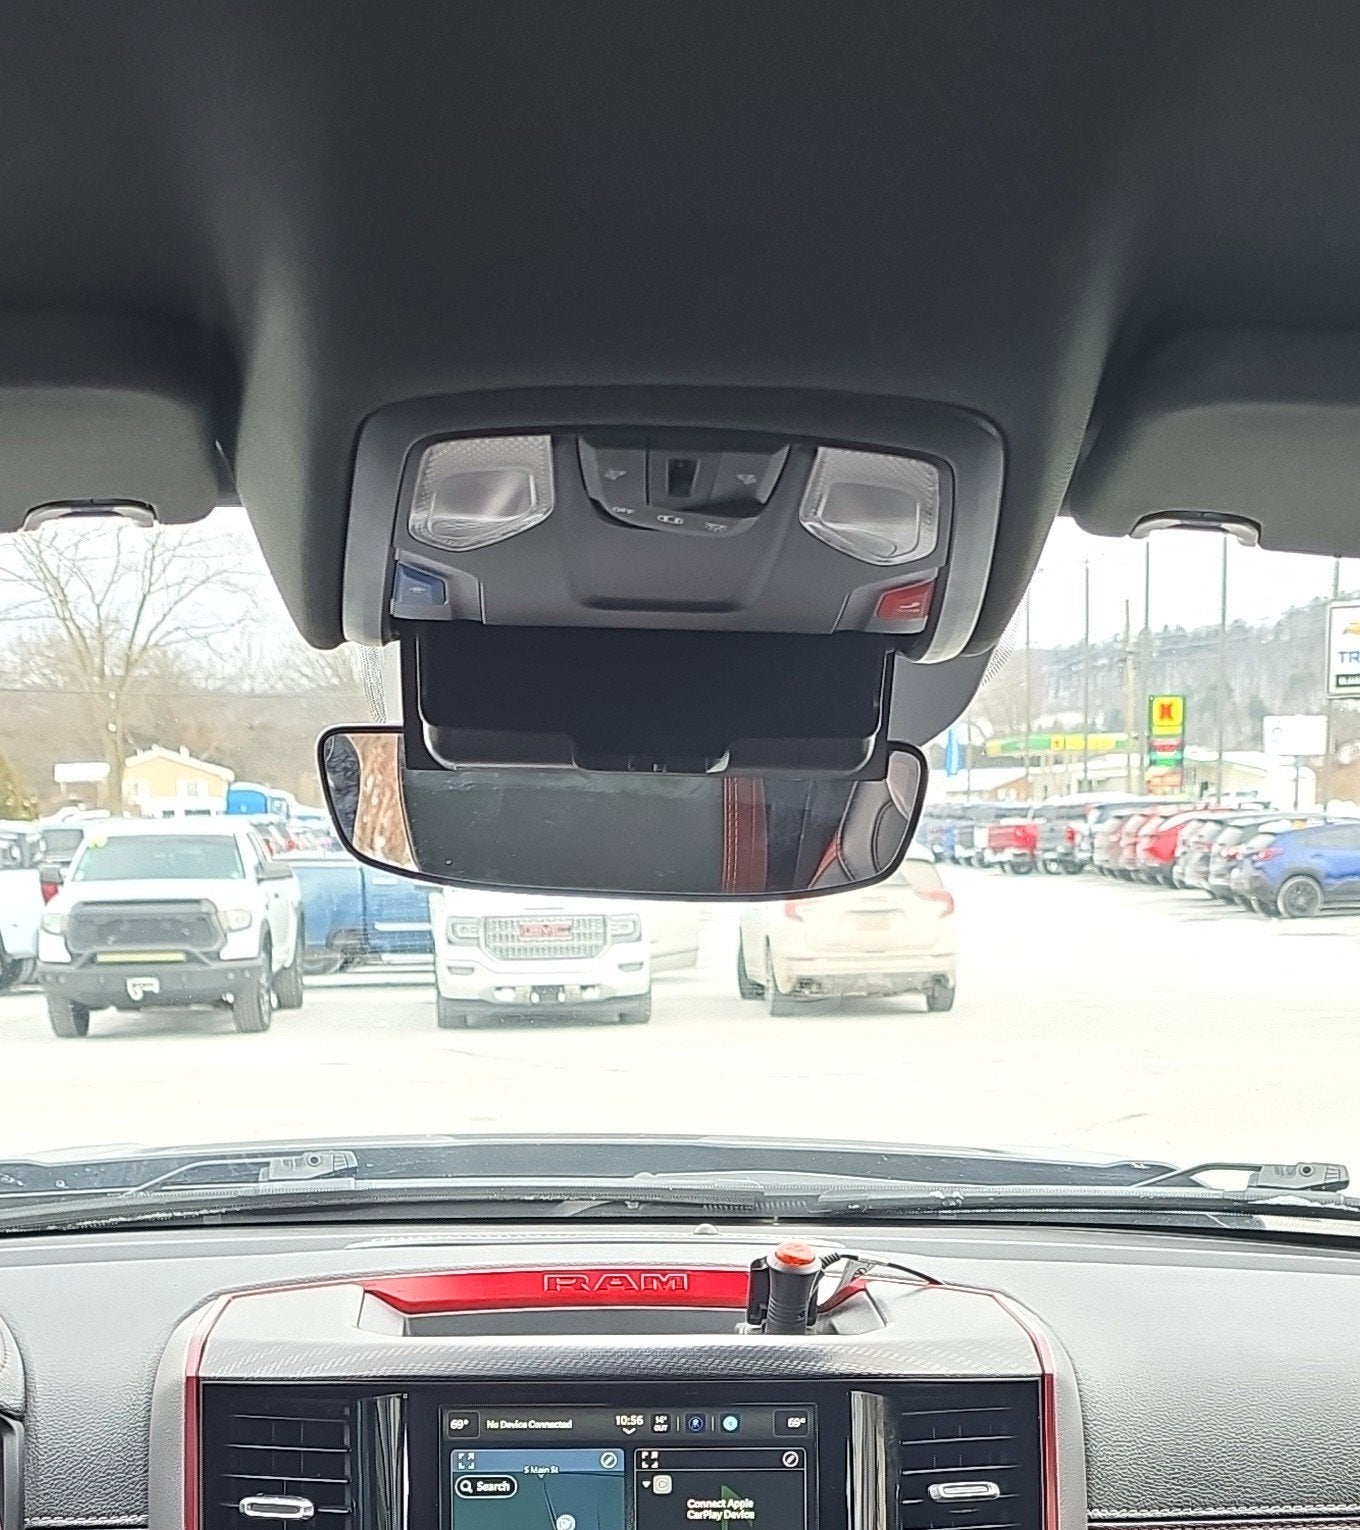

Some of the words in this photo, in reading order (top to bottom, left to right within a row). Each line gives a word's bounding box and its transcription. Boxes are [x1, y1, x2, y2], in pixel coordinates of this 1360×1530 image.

[543, 1273, 688, 1292] RAM
[500, 1420, 527, 1429] Device
[528, 1420, 573, 1429] Connected
[615, 1415, 644, 1426] 10:56
[476, 1480, 511, 1492] Search
[687, 1499, 726, 1509] Connect
[728, 1498, 754, 1510] Apple
[687, 1509, 723, 1521] CarPlay
[724, 1510, 755, 1520] Device
